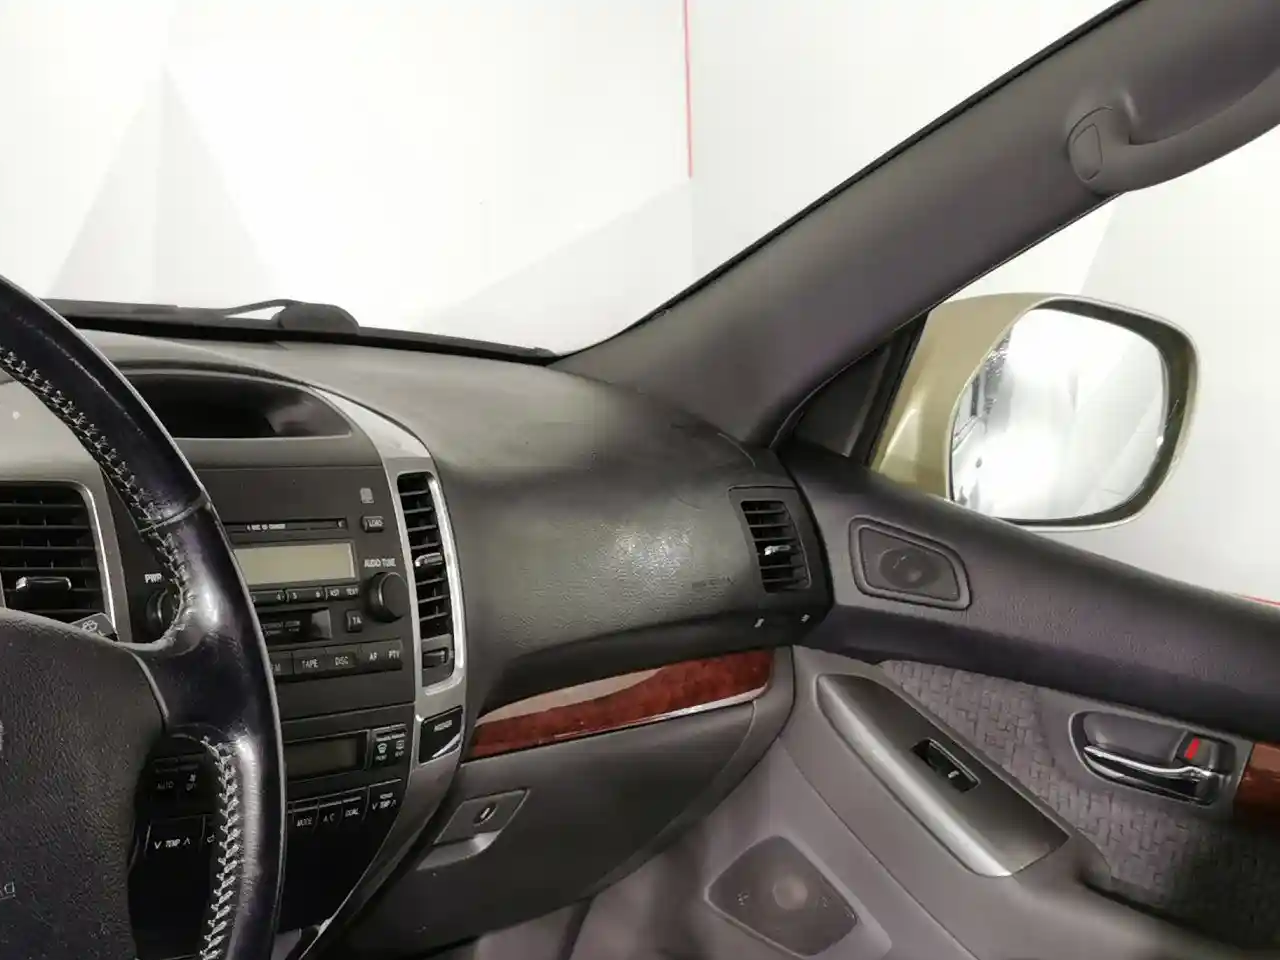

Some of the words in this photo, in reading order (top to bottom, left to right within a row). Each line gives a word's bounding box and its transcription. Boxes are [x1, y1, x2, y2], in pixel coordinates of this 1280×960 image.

[144, 573, 162, 583] PWR
[302, 659, 319, 669] TAPE
[335, 656, 349, 666] DISC
